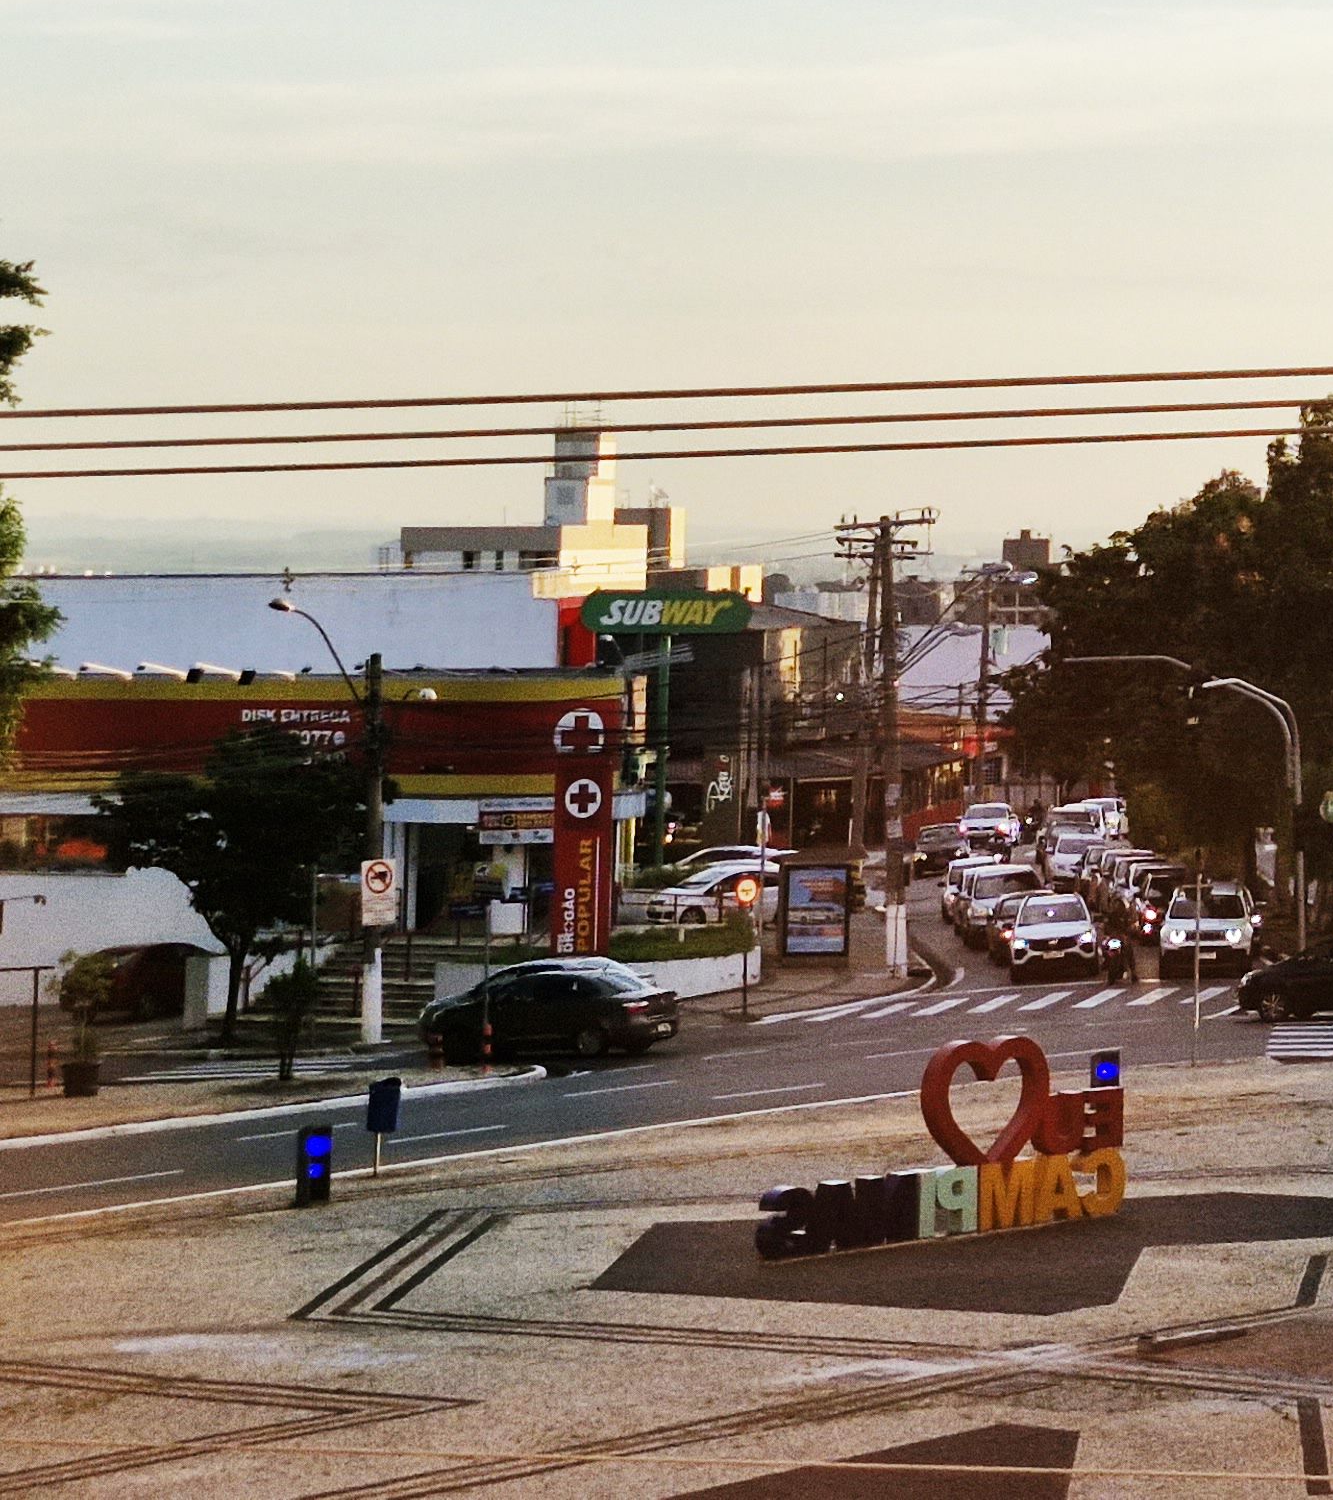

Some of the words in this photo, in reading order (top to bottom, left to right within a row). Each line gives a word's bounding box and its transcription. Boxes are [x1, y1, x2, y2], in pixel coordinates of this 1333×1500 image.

[600, 599, 733, 625] SUBWAY
[241, 708, 277, 722] DISK
[577, 838, 593, 952] POPULAR
[562, 888, 576, 953] DROGÃO
